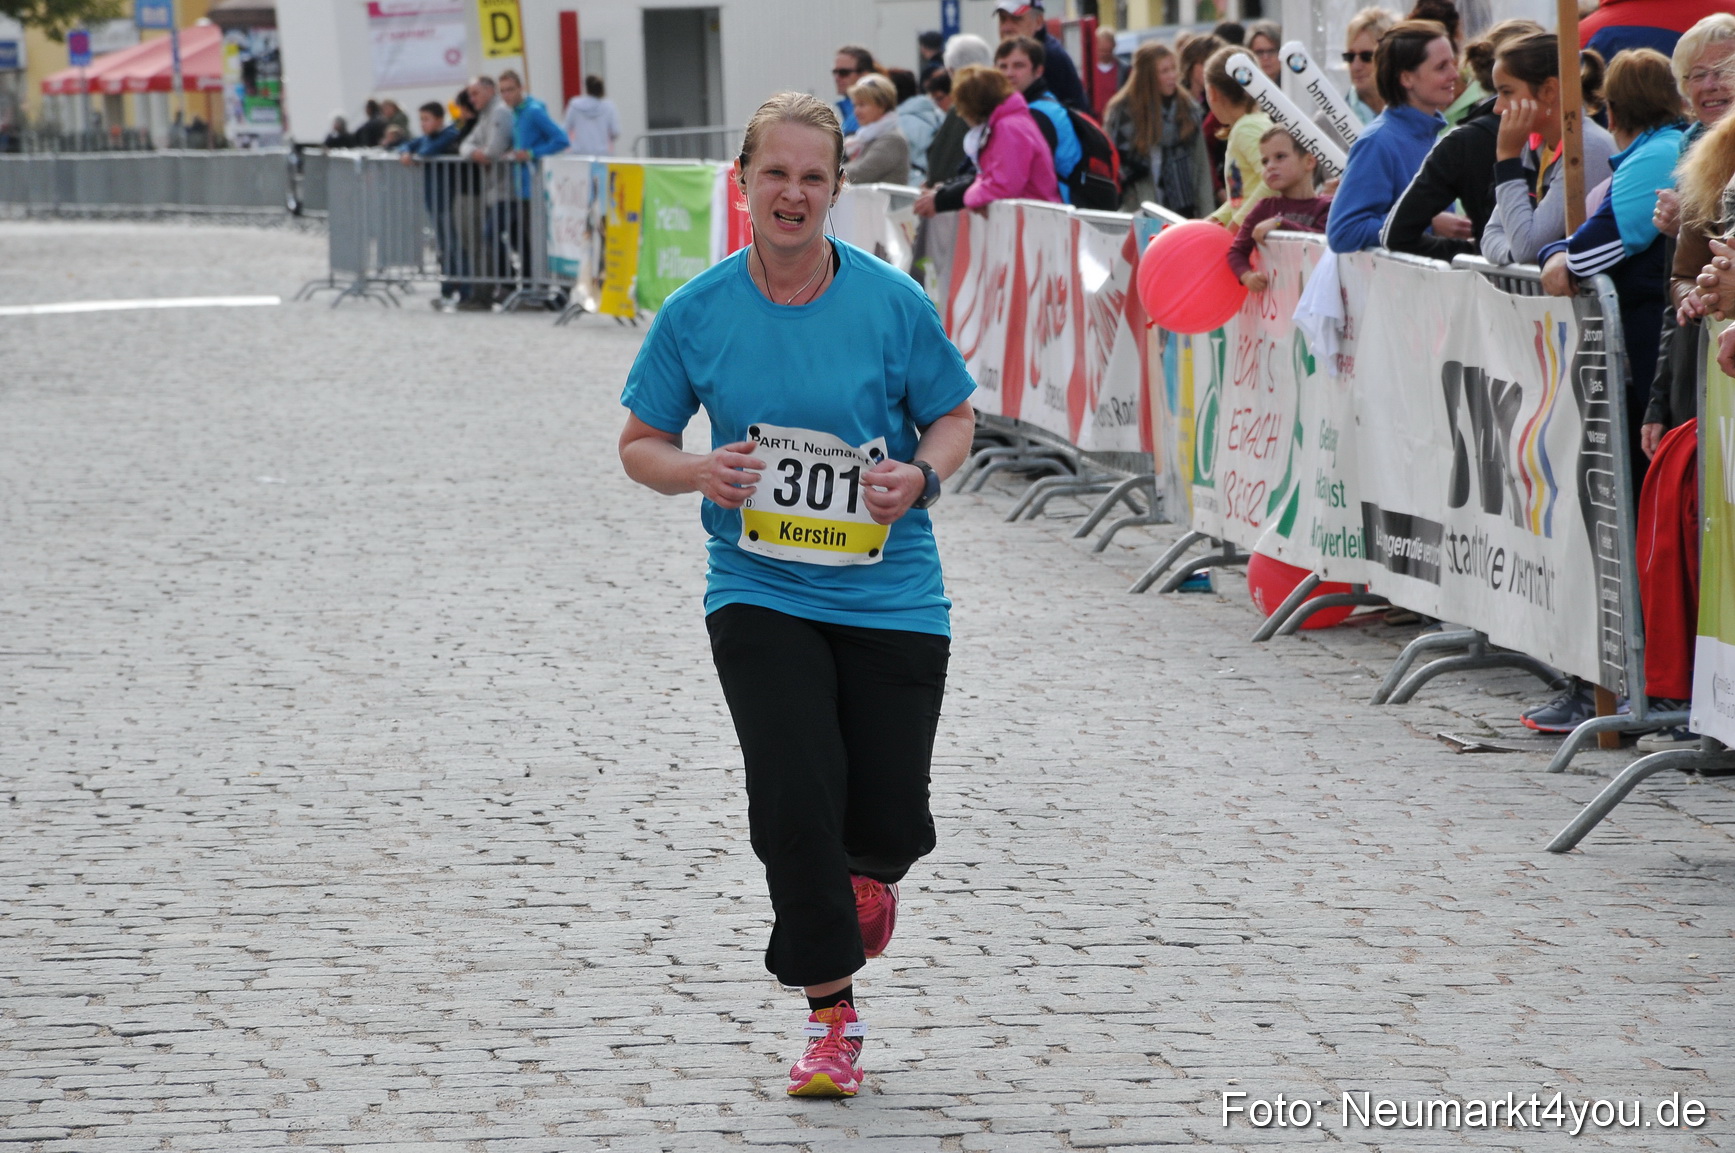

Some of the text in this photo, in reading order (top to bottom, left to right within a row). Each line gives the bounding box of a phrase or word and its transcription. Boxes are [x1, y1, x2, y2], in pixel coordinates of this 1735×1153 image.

[490, 12, 513, 43] D
[1255, 89, 1345, 178] bmw-laufsport
[751, 434, 870, 465] PARTL Neumart
[773, 458, 861, 514] 301
[779, 520, 847, 547] Kerstin
